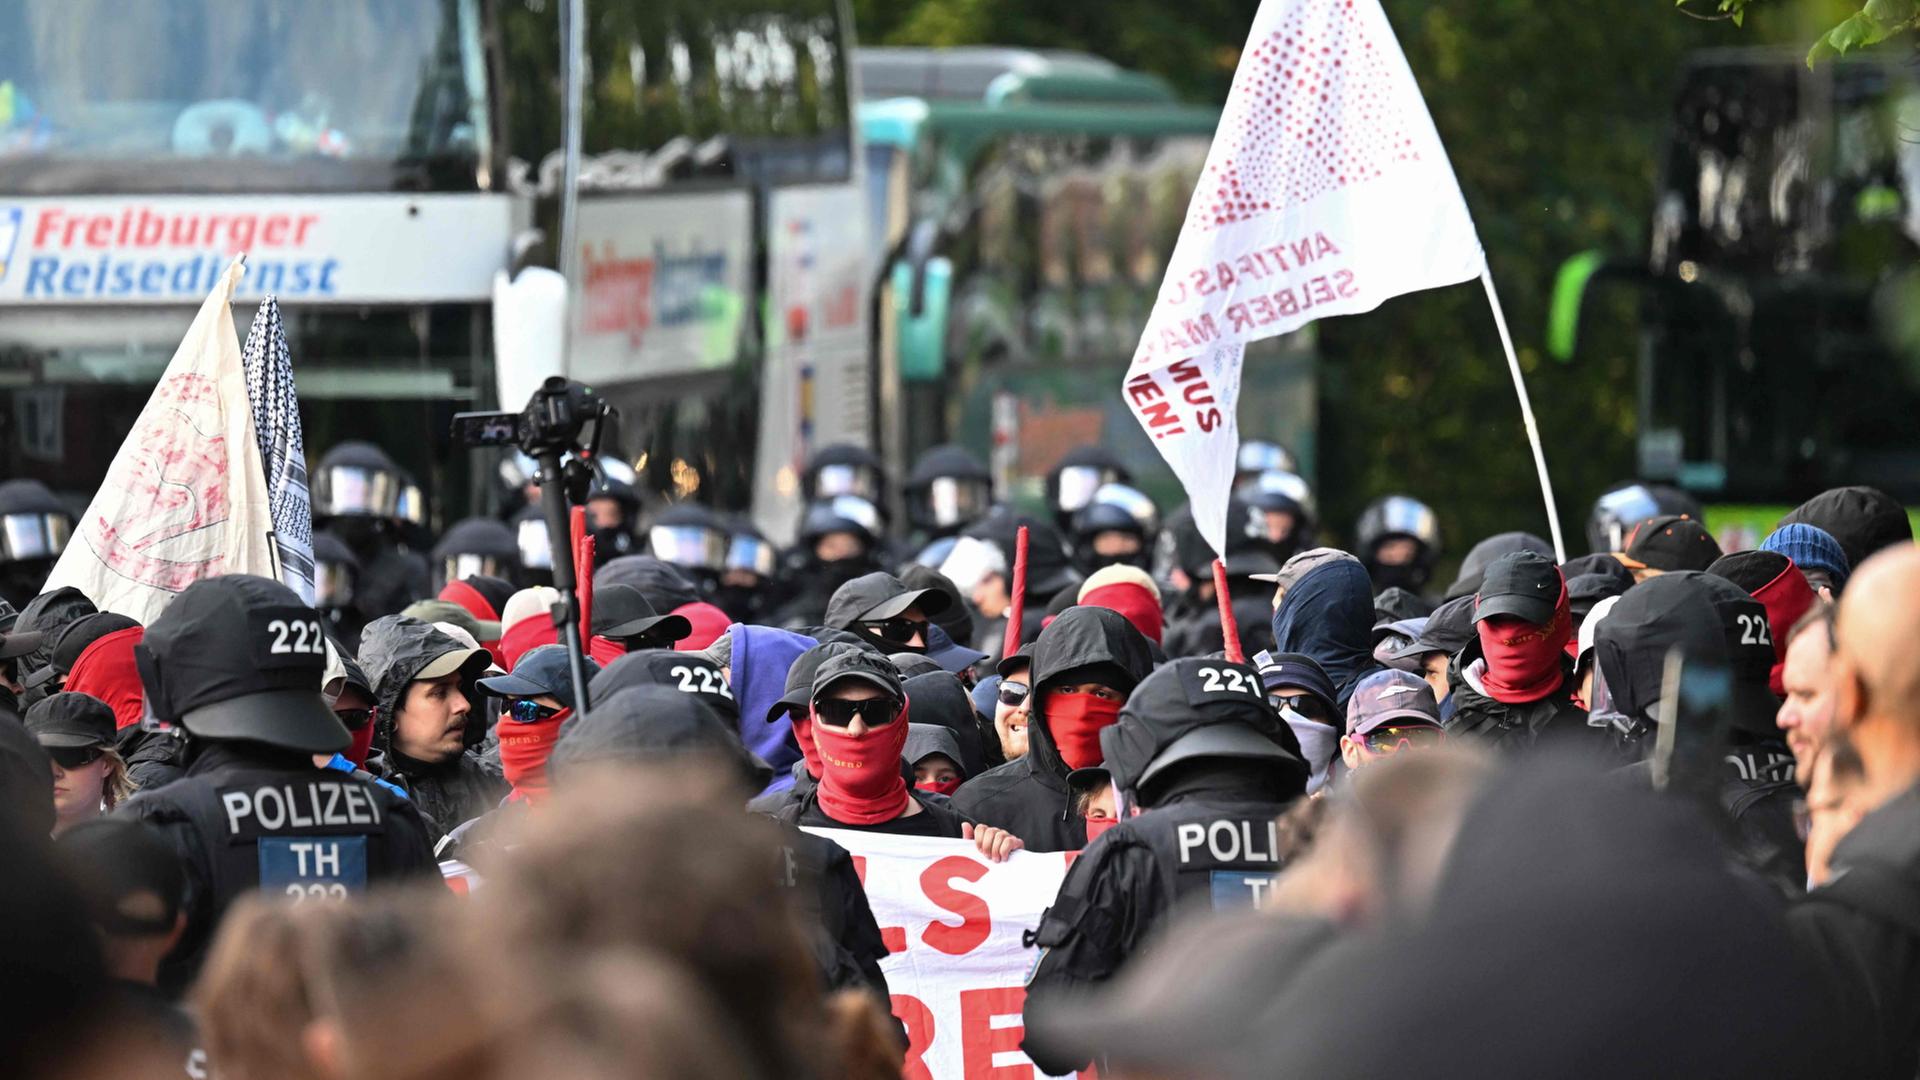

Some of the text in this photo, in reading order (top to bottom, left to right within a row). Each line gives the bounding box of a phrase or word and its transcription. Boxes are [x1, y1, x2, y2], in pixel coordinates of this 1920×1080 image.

[31, 206, 320, 255] Freiburger
[25, 252, 341, 296] Reisedinst
[267, 619, 324, 655] 222
[1736, 613, 1773, 646] 22
[670, 664, 734, 700] 222
[1197, 666, 1263, 699] 221
[222, 782, 381, 834] POLIZEI
[289, 842, 340, 876] TH
